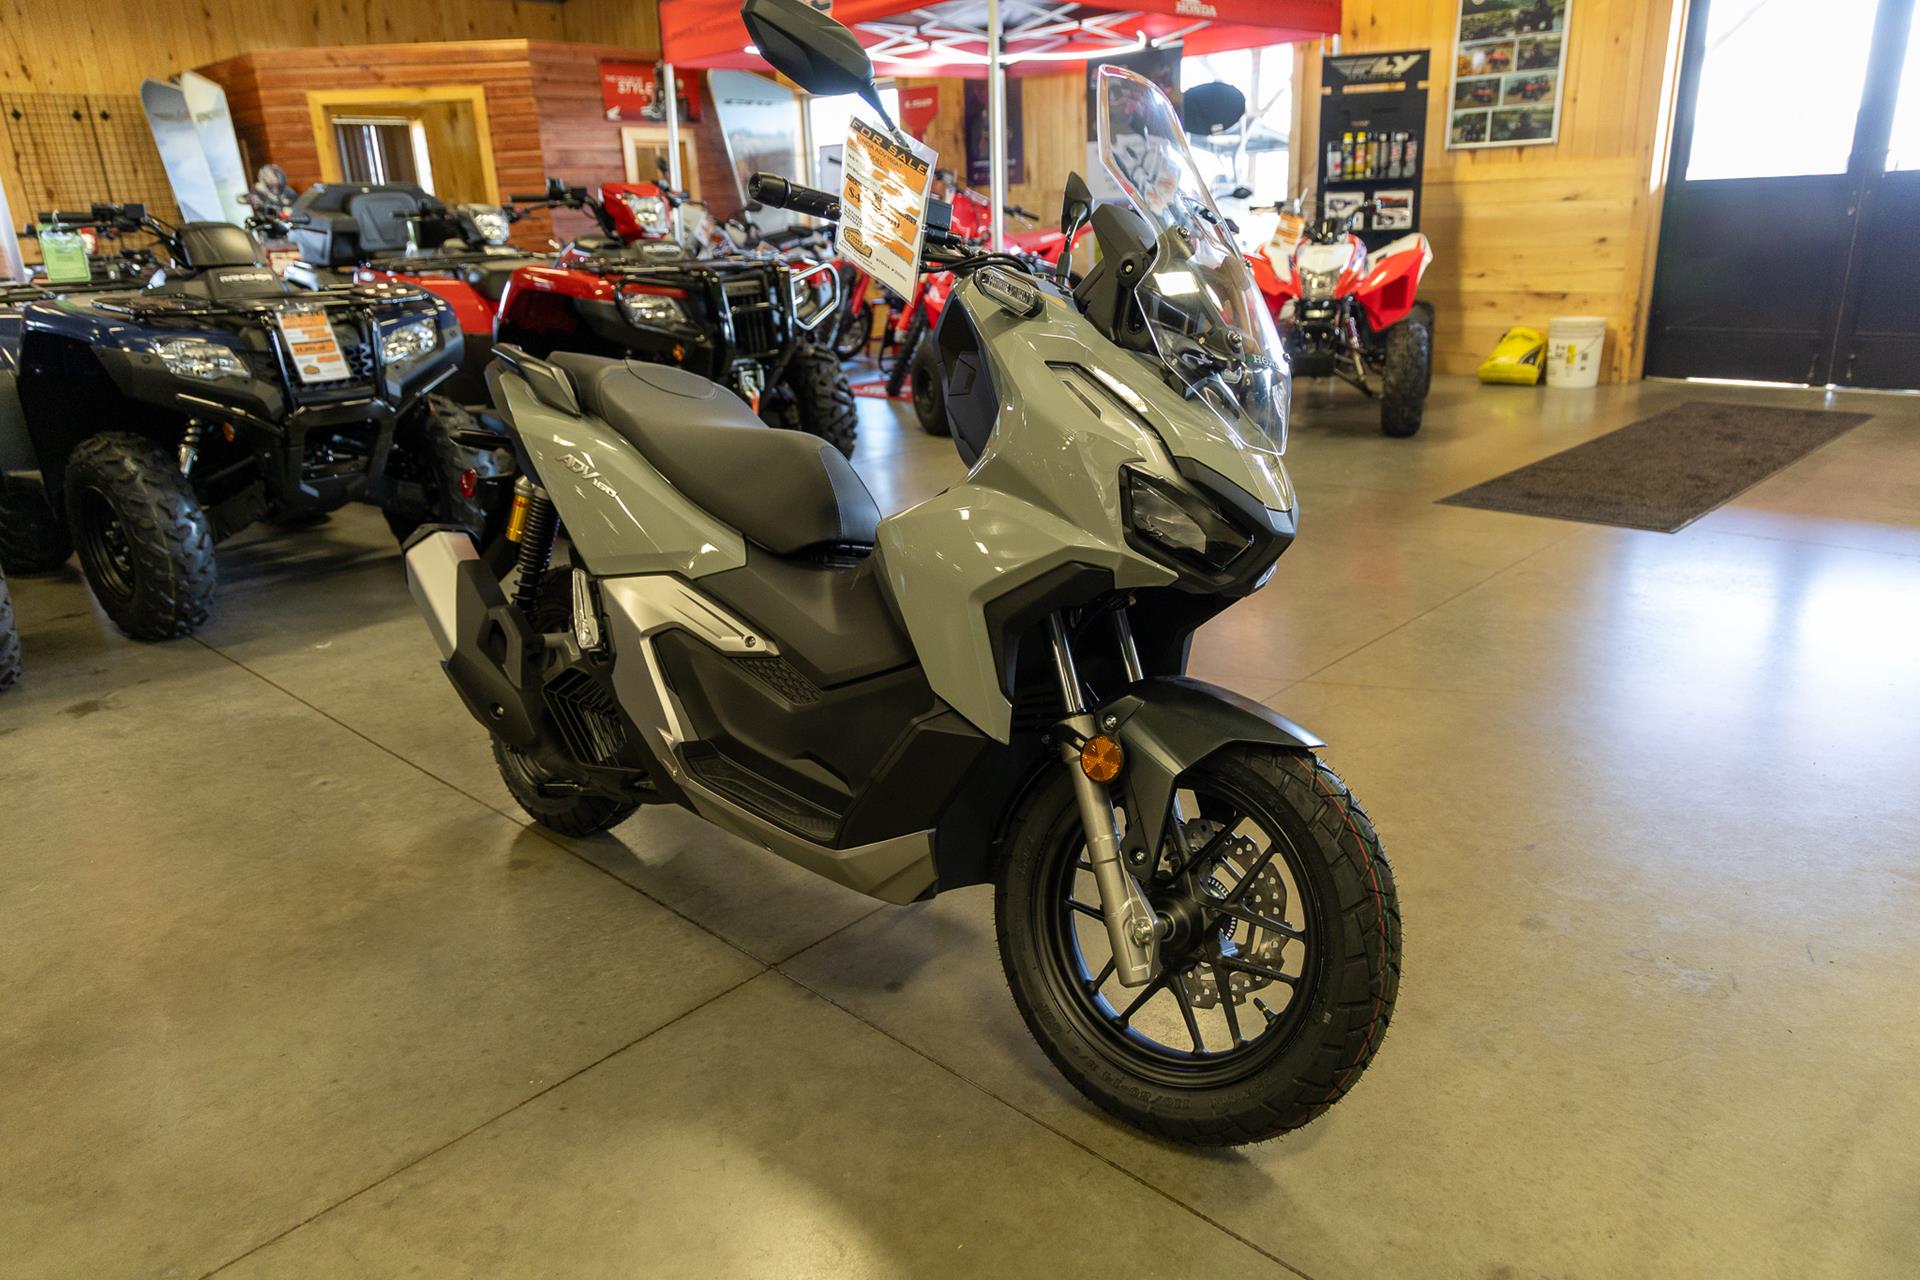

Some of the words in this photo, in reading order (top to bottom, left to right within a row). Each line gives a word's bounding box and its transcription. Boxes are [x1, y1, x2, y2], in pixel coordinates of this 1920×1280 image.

[1176, 4, 1217, 17] HONDA
[617, 80, 654, 95] STYLE
[851, 120, 883, 145] FOR
[887, 143, 927, 175] SALE
[555, 453, 600, 479] ADV
